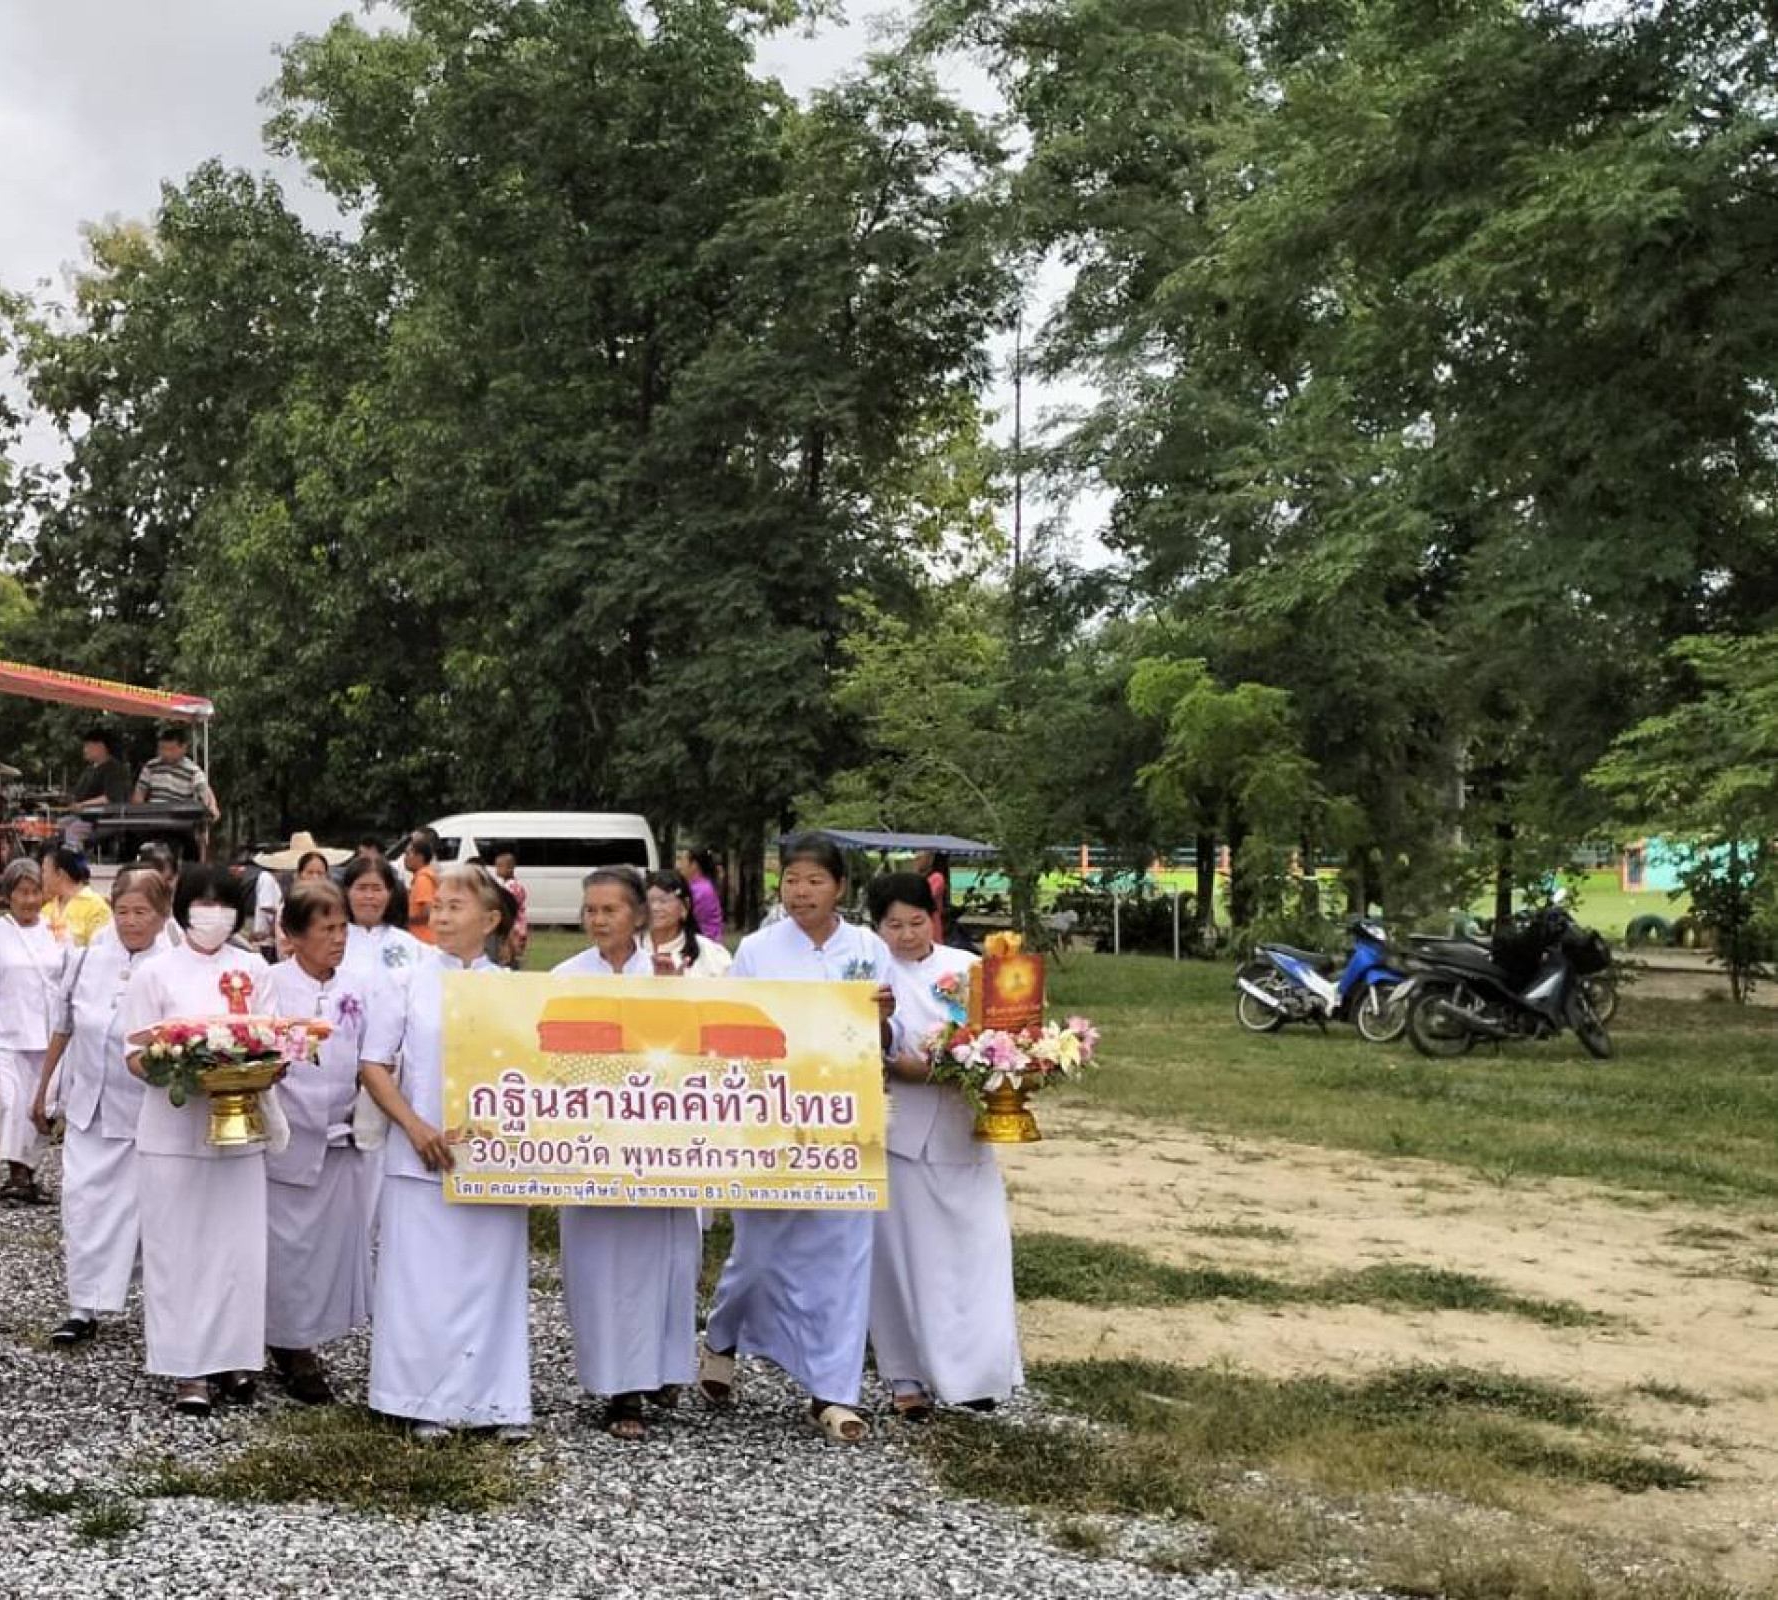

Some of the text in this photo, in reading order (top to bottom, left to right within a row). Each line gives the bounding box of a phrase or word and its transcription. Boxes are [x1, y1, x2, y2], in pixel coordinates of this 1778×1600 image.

[472, 1065, 854, 1132] กฐินสามัคคีทั่วไทย
[472, 1135, 859, 1176] 30,000วัด พุทธศักราช 2568
[453, 1176, 483, 1195] โดย
[705, 1186, 723, 1199] 81
